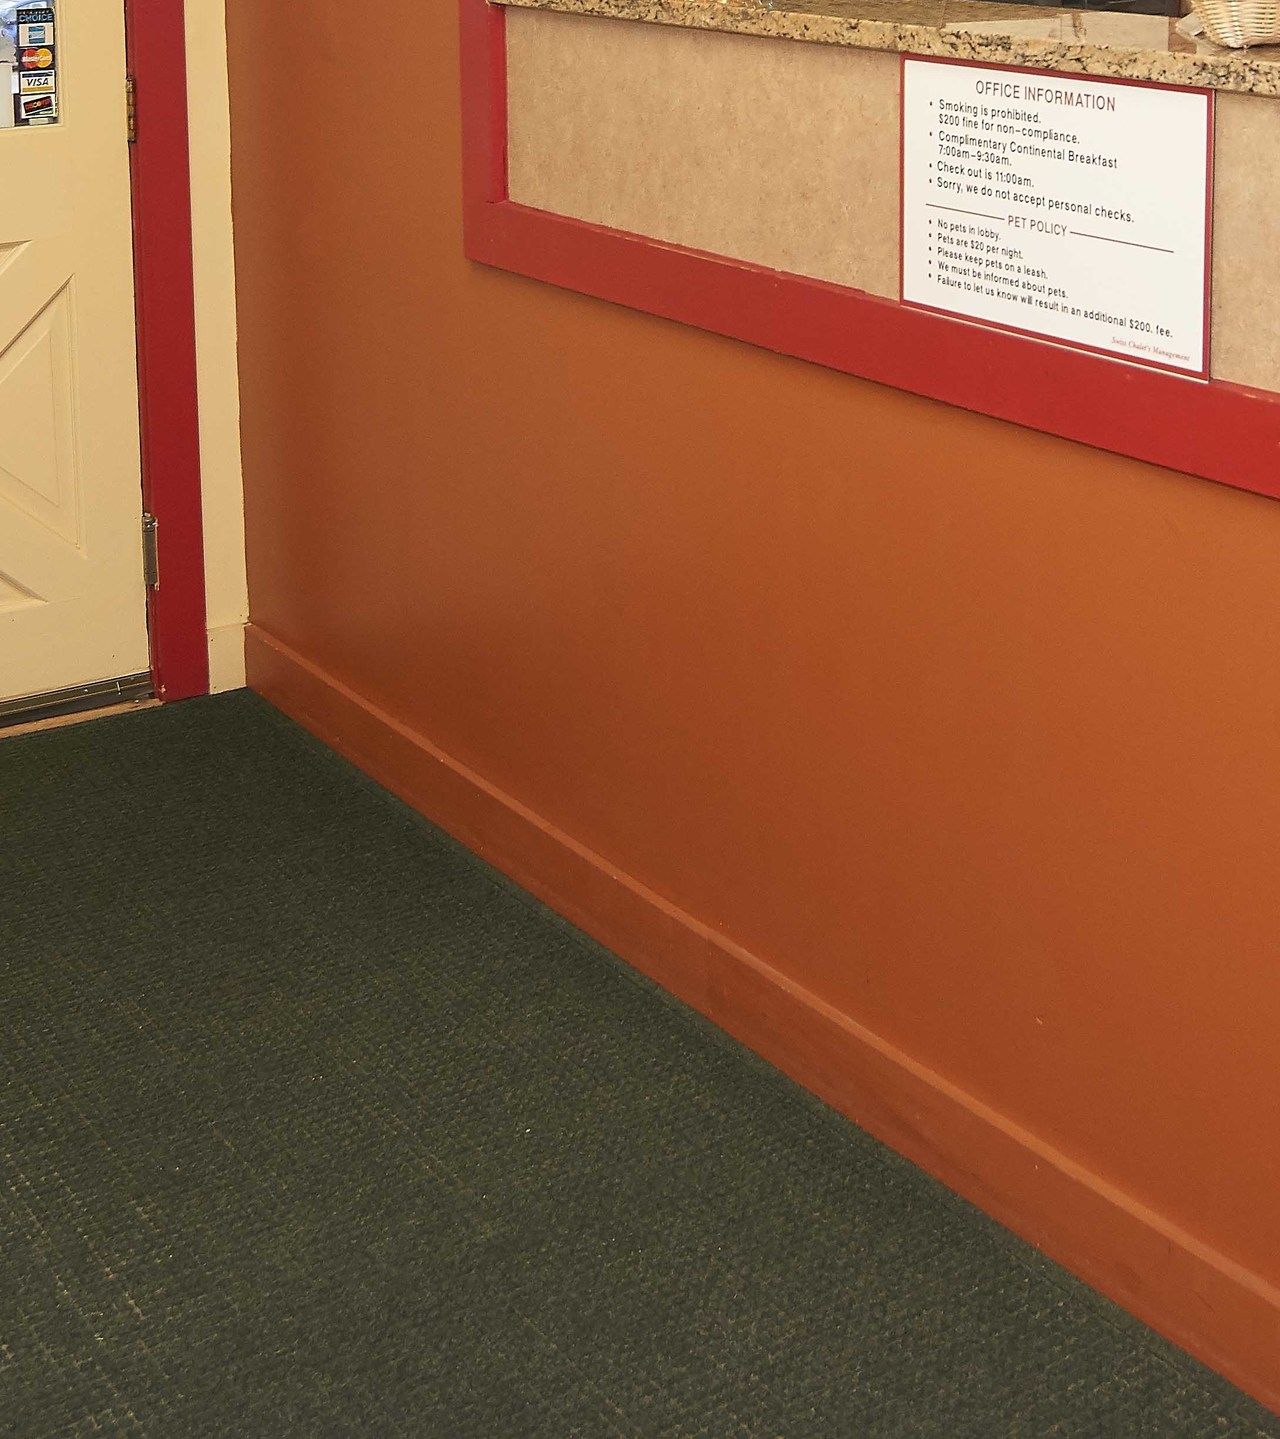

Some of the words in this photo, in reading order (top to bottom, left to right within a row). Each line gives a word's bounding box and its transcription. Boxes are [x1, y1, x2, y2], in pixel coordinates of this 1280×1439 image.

[19, 13, 53, 22] CHOICE
[26, 77, 49, 86] VISA
[975, 80, 1020, 99] OFFICE
[1024, 86, 1116, 111] INFORMATION
[939, 99, 978, 117] Smoking
[981, 105, 988, 116] is
[991, 107, 1041, 123] prohibited.
[939, 114, 959, 126] $200
[963, 116, 978, 129] fine
[982, 119, 994, 131] for
[939, 131, 1007, 153] Complimentary
[1010, 141, 1065, 160] Continental
[1069, 150, 1117, 168] Breakfast
[937, 161, 965, 175] Check
[968, 167, 982, 179] out
[985, 170, 992, 180] is
[996, 171, 1034, 187] 11:00am.
[937, 177, 963, 193] Sorry,
[966, 184, 978, 194] we
[981, 185, 992, 196] do
[995, 189, 1010, 200] not
[1013, 193, 1046, 208] accept
[1048, 200, 1092, 215] personal
[1094, 206, 1134, 222] checks.
[937, 219, 947, 229] No
[950, 222, 966, 233] pets
[969, 224, 975, 234] in
[978, 226, 1001, 242] lobby.
[1008, 215, 1027, 229] PET
[1030, 219, 1067, 236] POLICY
[937, 233, 954, 244] Pets
[956, 238, 968, 247] are
[970, 240, 984, 251] $20
[986, 245, 999, 254] per
[1001, 246, 1023, 259] night.
[937, 247, 962, 261] Please
[965, 252, 983, 266] keep
[985, 259, 1002, 269] pets
[1005, 263, 1015, 272] on
[1017, 265, 1021, 273] a
[1024, 265, 1048, 279] leash.
[938, 261, 949, 271] We
[951, 265, 970, 276] must
[972, 268, 981, 279] be
[984, 271, 1020, 288] informed
[1022, 281, 1045, 293] about
[1048, 287, 1068, 299] pets.
[937, 275, 962, 289] Failure
[964, 281, 971, 291] to
[974, 283, 983, 293] let
[985, 287, 994, 296] us
[996, 289, 1018, 301] know
[1020, 294, 1032, 305] will
[1035, 298, 1059, 312] result
[1061, 303, 1068, 313] in
[1071, 307, 1081, 316] an
[1084, 310, 1127, 327] additional
[1129, 319, 1153, 333] $200.
[1156, 325, 1173, 338] fee.
[1153, 346, 1190, 361] Management
